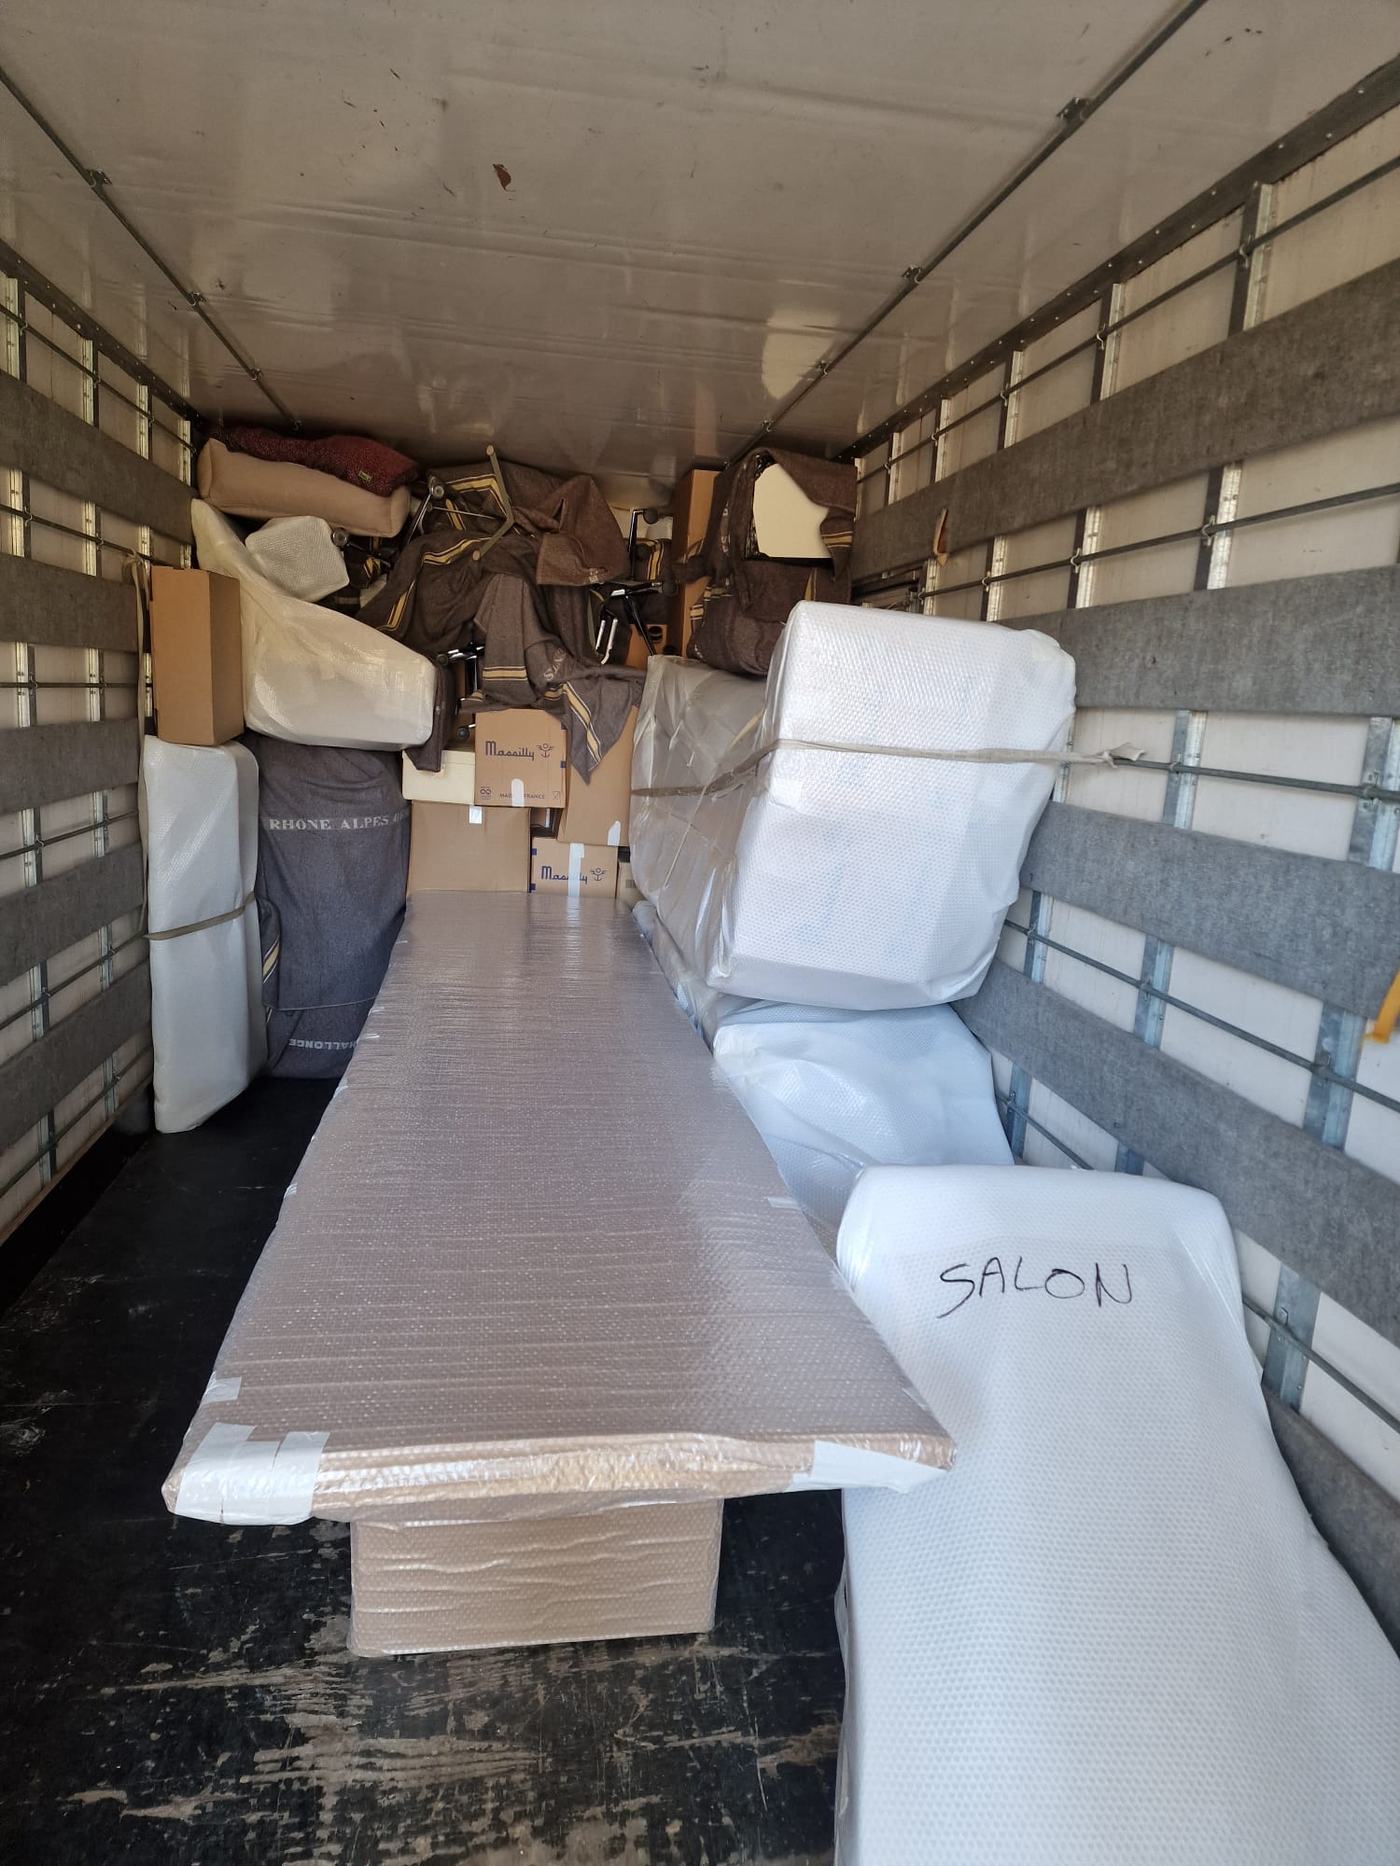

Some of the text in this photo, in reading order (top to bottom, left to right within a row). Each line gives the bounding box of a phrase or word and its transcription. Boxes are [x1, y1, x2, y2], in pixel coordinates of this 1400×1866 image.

[485, 740, 535, 761] Massilly
[269, 818, 331, 830] RHONE
[340, 815, 389, 830] ALPES
[541, 865, 588, 885] Masly
[936, 1256, 1133, 1319] SALON
